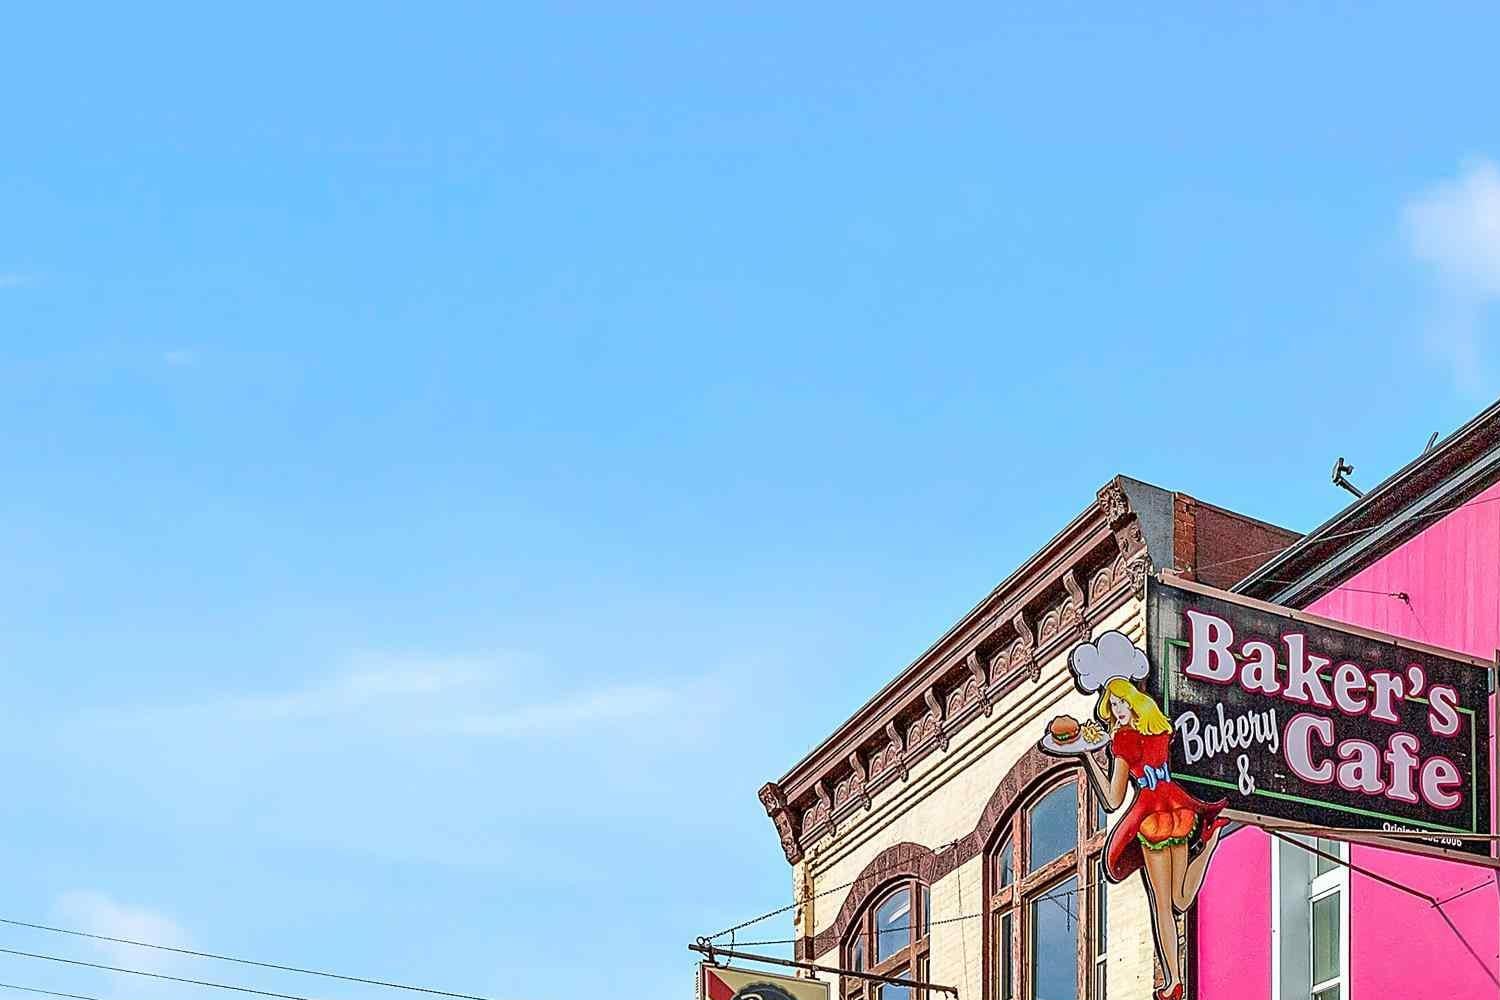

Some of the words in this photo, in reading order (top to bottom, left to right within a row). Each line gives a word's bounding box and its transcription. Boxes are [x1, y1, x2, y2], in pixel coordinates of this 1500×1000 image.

[1185, 608, 1460, 737] Baker's
[1175, 703, 1279, 765] Bakery
[1283, 714, 1463, 810] Cafe
[1236, 755, 1256, 796] &
